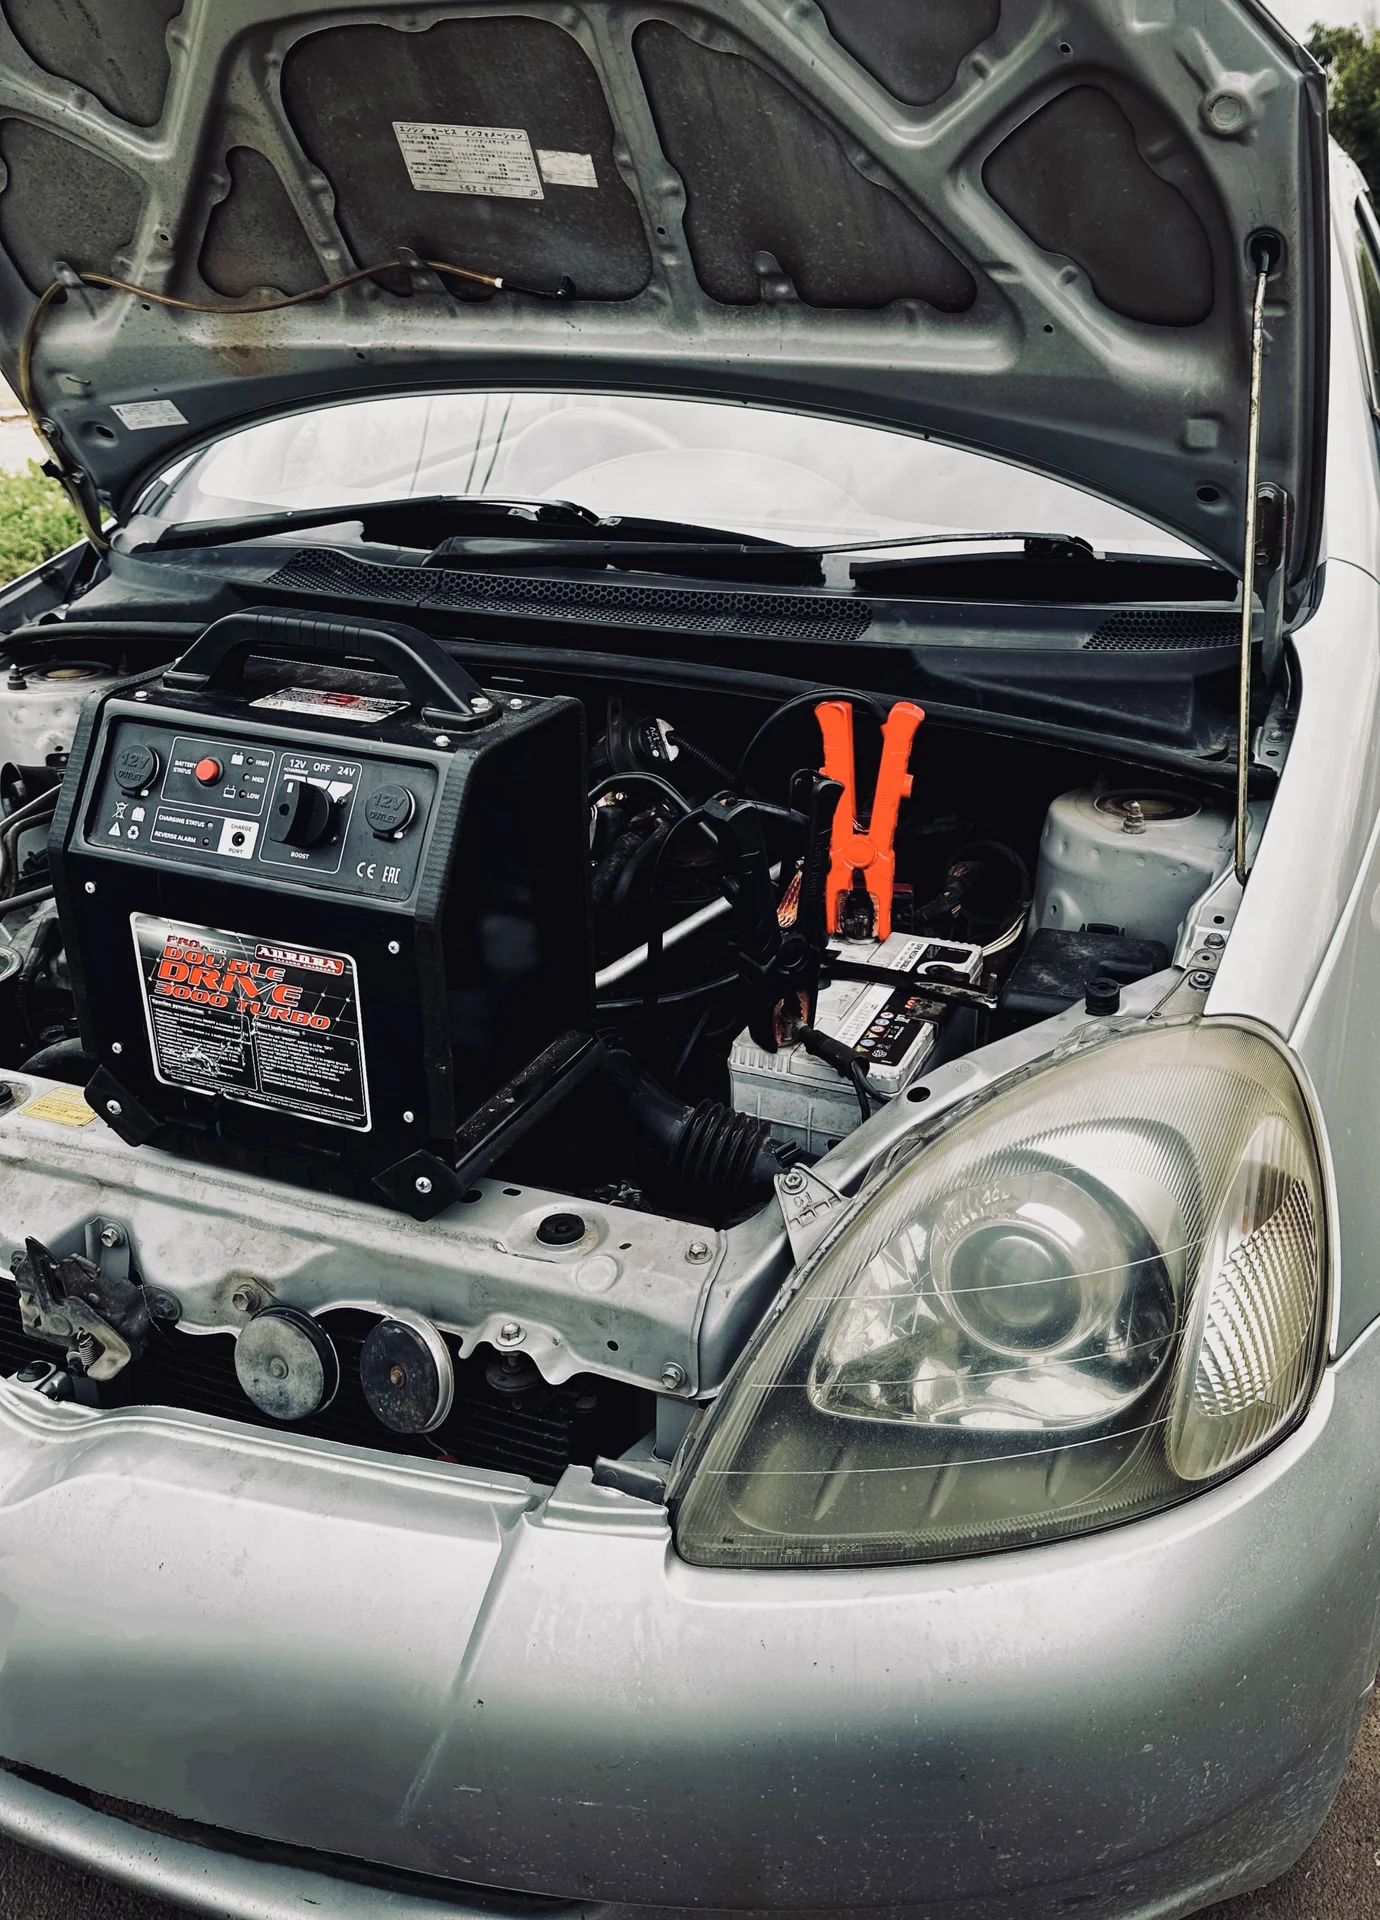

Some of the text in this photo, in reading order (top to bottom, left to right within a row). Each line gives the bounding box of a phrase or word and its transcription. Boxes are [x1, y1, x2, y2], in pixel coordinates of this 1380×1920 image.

[121, 752, 150, 770] 12V
[174, 760, 197, 769] BATTERY
[255, 759, 270, 767] HIGH
[289, 759, 356, 776] 12V OFF 24V
[118, 770, 143, 782] OUTLET
[173, 767, 191, 775] STATUS
[251, 776, 265, 784] MED
[246, 792, 260, 800] LOW
[373, 793, 406, 811] 12V
[158, 814, 205, 828] CHARGING STATUS
[369, 811, 398, 824] OUTLET
[230, 823, 252, 832] CHARGE
[154, 830, 197, 843] REVERSE ALARM
[290, 851, 310, 860] BOOST
[163, 945, 286, 982] DOUBLE
[258, 947, 339, 971] AURORA
[157, 958, 303, 1007] DRIVE
[154, 980, 331, 1030] 3000 TURBO
